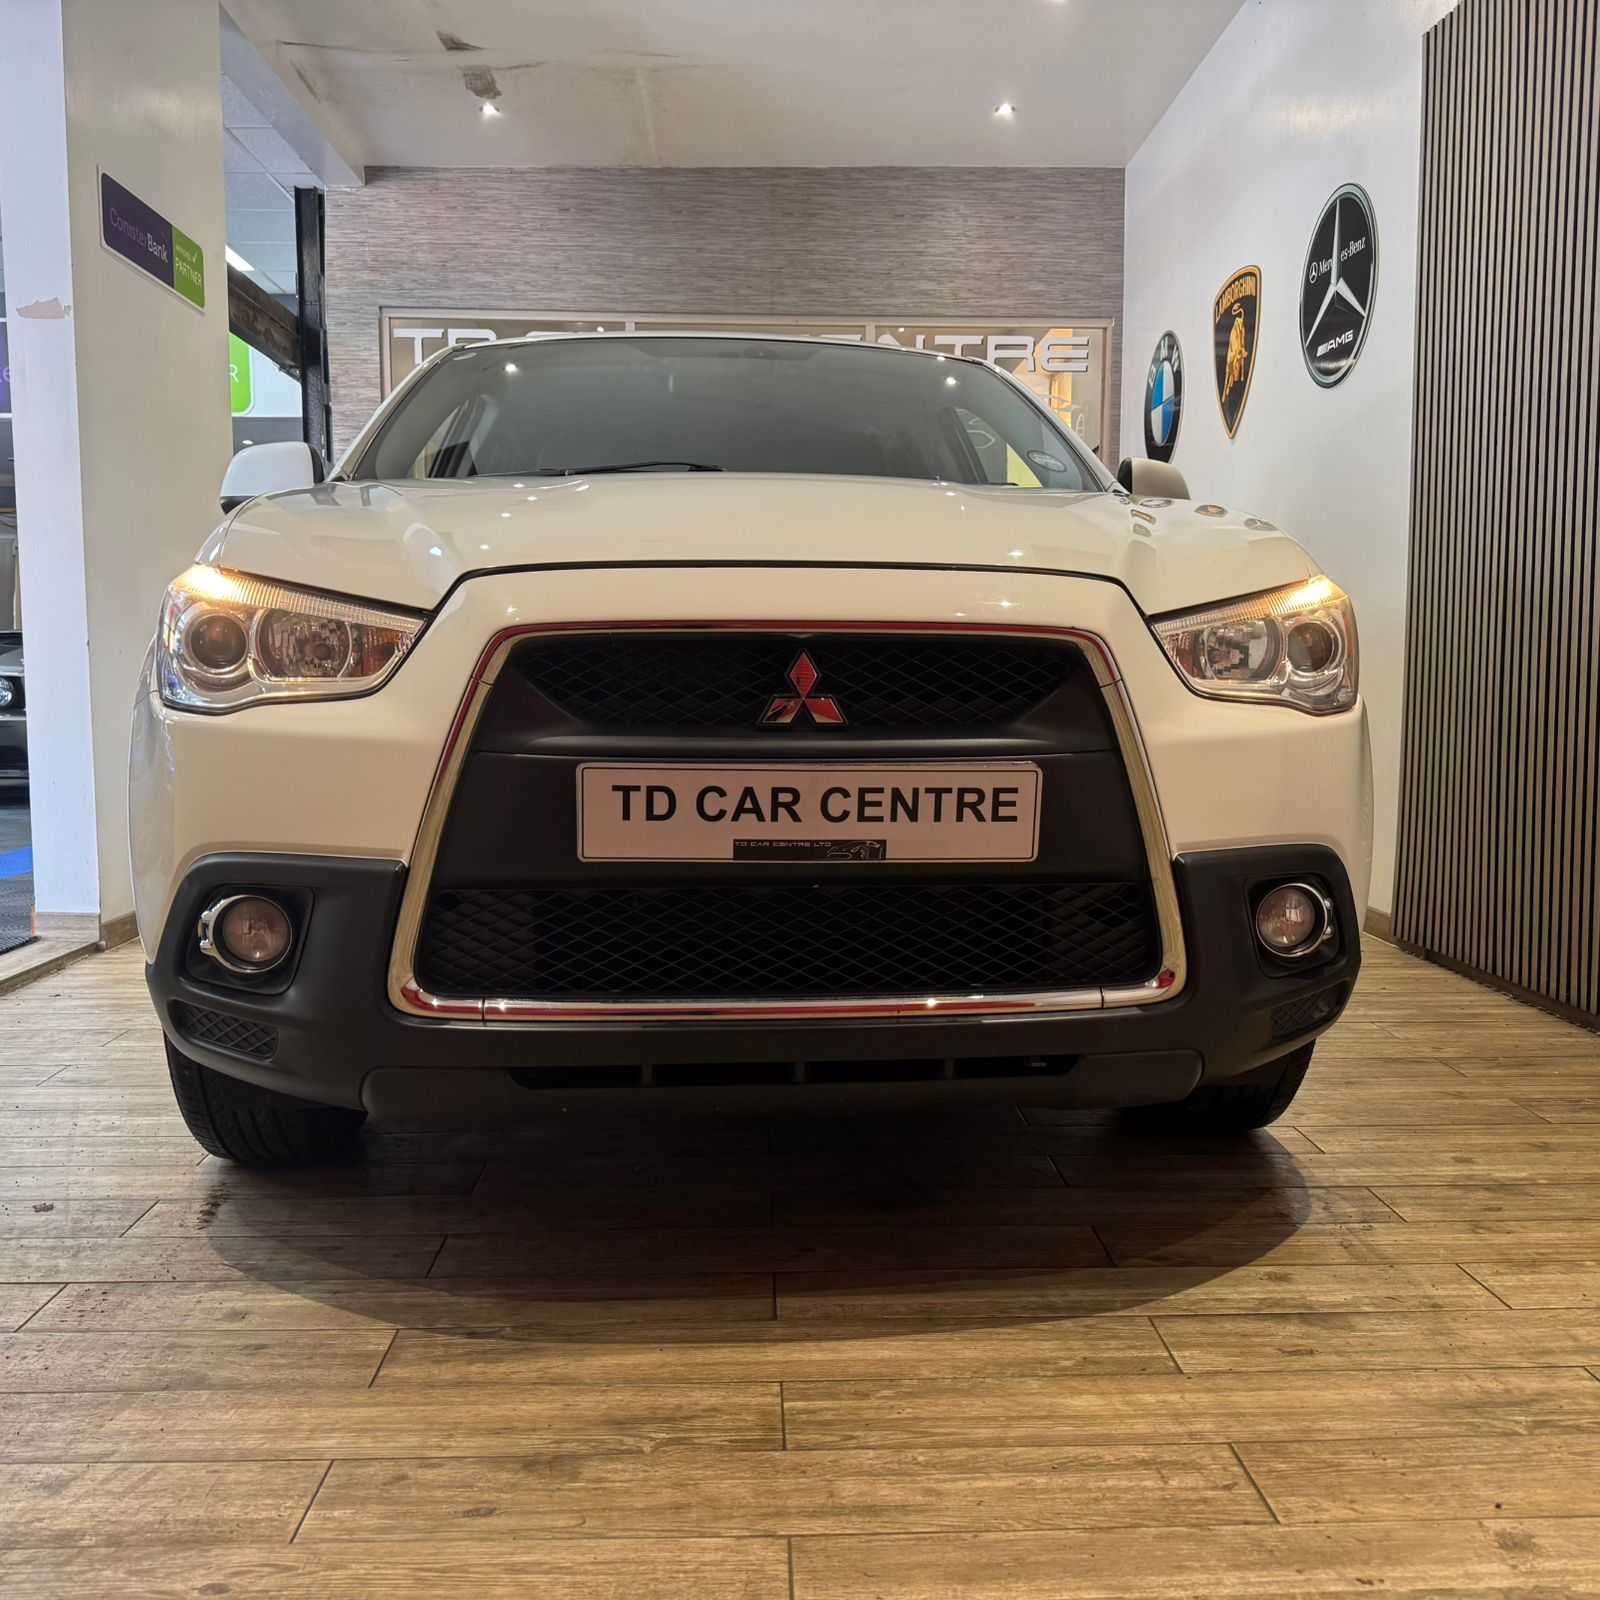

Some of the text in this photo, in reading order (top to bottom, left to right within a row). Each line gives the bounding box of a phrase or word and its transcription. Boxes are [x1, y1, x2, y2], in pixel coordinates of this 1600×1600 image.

[175, 256, 202, 287] PARTNER
[1318, 236, 1366, 276] Meres-Benz
[611, 785, 1019, 823] TD CAR CENTRE
